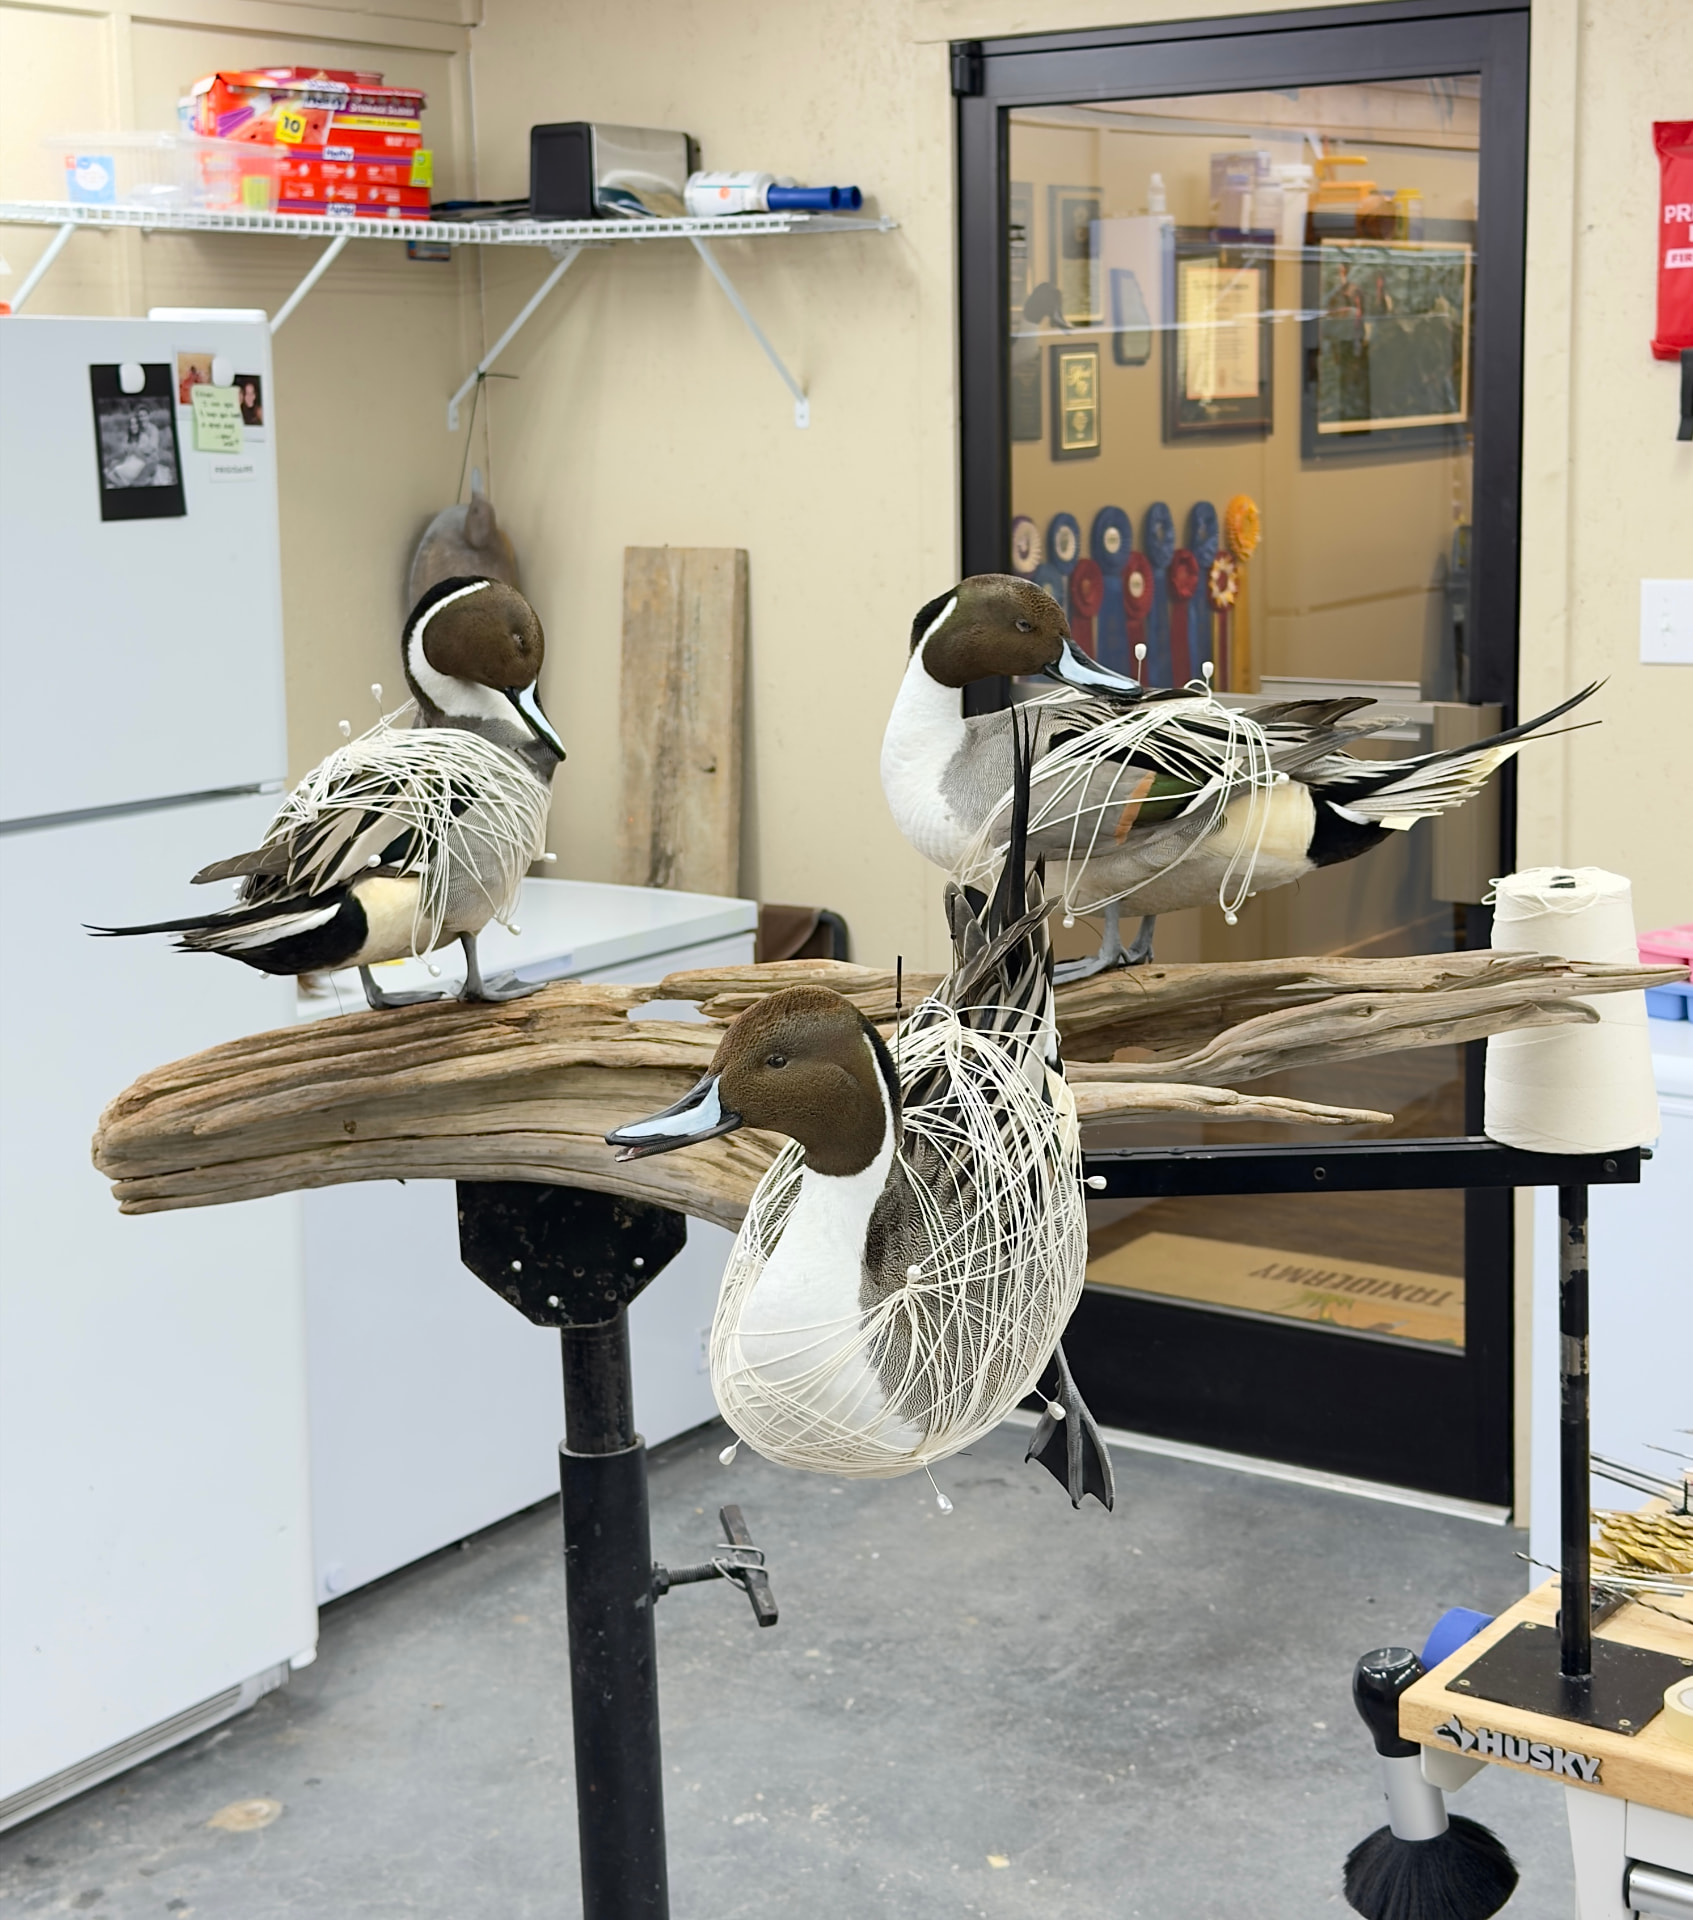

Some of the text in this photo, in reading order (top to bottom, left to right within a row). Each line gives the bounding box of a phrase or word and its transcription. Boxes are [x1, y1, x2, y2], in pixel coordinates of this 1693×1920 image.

[284, 115, 301, 133] 10
[1664, 203, 1693, 224] PR
[1249, 1263, 1454, 1307] TAXIDERMY
[1477, 1726, 1601, 1784] HUSKY
